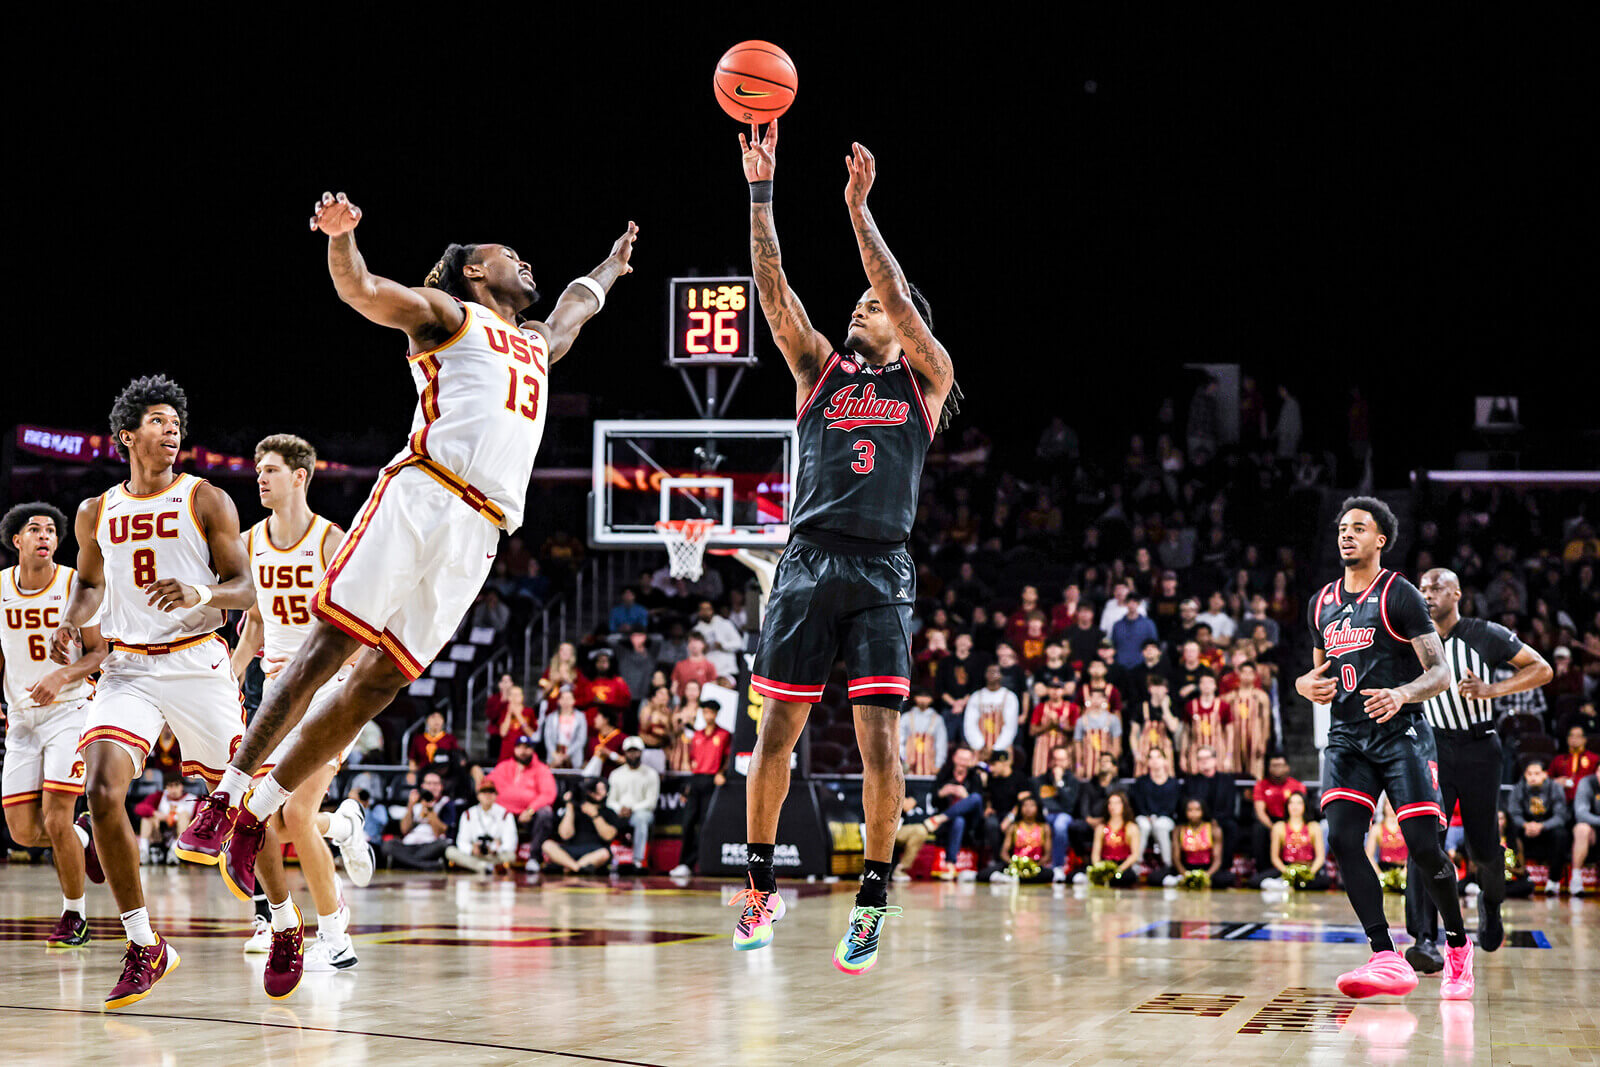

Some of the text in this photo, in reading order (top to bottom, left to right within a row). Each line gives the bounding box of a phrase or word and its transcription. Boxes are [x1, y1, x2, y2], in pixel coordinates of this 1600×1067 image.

[688, 285, 746, 311] 11:26
[686, 311, 739, 354] 26
[484, 325, 546, 376] USC
[505, 366, 540, 421] 13
[823, 382, 910, 425] Indiana
[851, 439, 876, 475] 3
[109, 511, 179, 544] USC
[133, 547, 157, 589] 8
[259, 565, 314, 589] USC
[5, 607, 60, 630] USC
[272, 594, 310, 626] 45
[28, 634, 47, 662] 6
[1324, 617, 1376, 650] Indiana
[1341, 663, 1357, 692] 0
